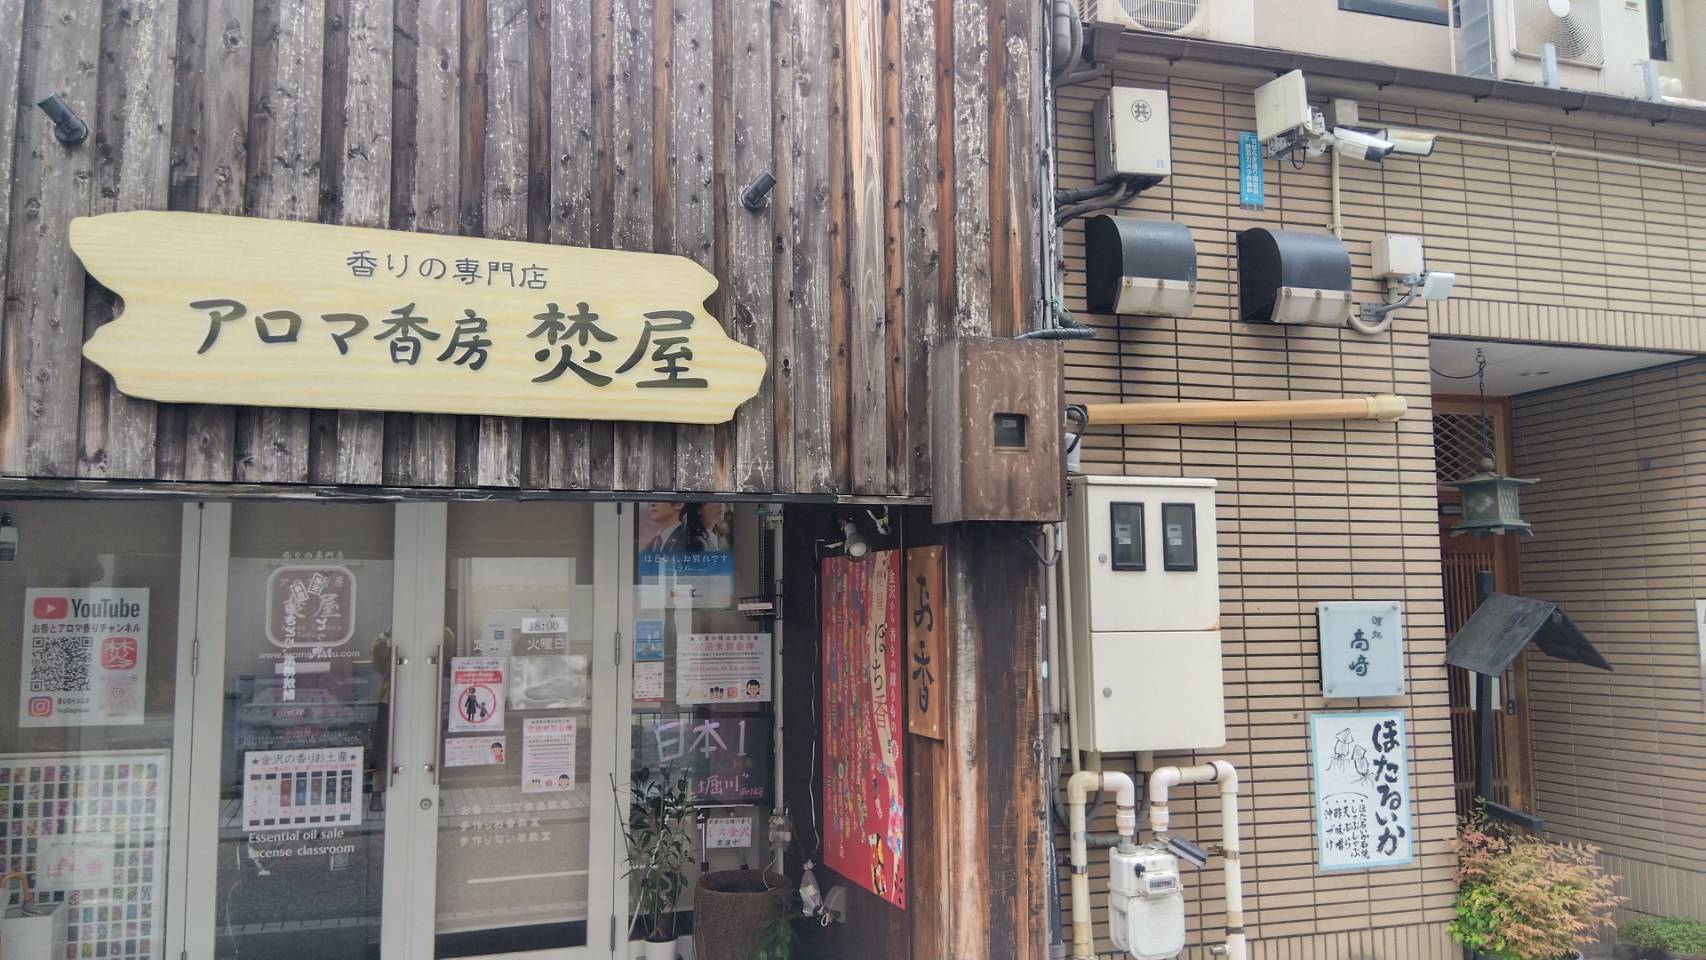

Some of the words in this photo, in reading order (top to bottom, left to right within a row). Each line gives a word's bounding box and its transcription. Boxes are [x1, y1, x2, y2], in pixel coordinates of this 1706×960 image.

[346, 249, 549, 290] 香りの専門店
[189, 298, 493, 371] アロマ香房
[526, 301, 709, 389] 焚屋
[71, 598, 140, 618] YouTube
[32, 623, 141, 634] お香とアロマ香りチャンネル
[529, 620, 559, 631] 18:00
[527, 638, 565, 650] 火曜日
[888, 569, 897, 734] 金沢から香りの贈りもの
[262, 751, 348, 765] 金沢の香りお土産
[1371, 719, 1405, 857] ほたるいか
[248, 830, 300, 843] Essential
[302, 830, 318, 841] oil
[321, 828, 345, 839] sale
[296, 844, 356, 857] classroom
